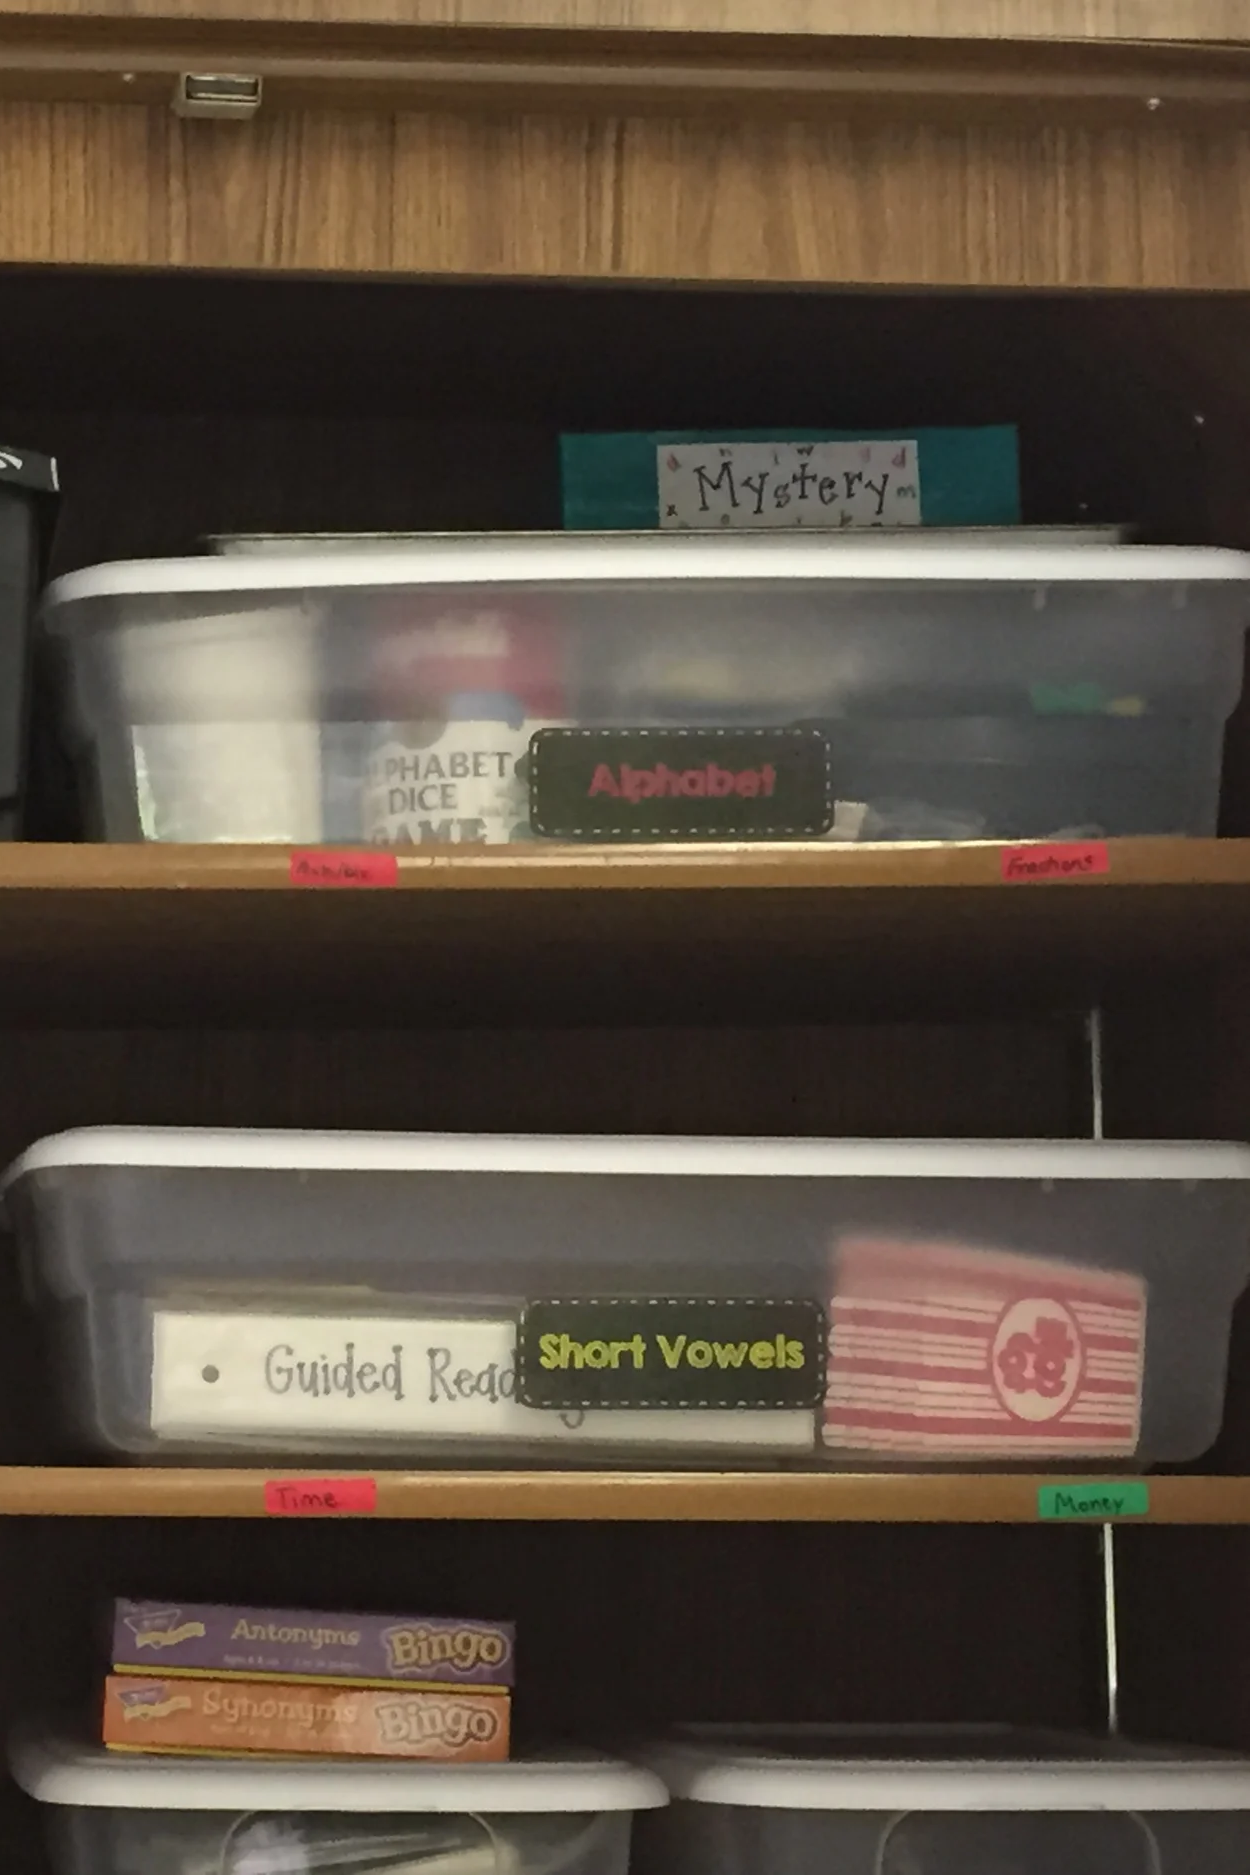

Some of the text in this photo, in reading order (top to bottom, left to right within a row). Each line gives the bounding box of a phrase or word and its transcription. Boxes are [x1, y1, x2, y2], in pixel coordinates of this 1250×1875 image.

[693, 460, 889, 516] Mystery
[364, 751, 513, 782] PHABET
[588, 761, 776, 804] Alphabet
[388, 783, 459, 815] DICE
[264, 1342, 405, 1401] Guided
[538, 1333, 805, 1370] Short Vowels
[274, 1486, 338, 1510] Time
[1054, 1491, 1125, 1515] Money
[230, 1618, 362, 1650] Antonyms
[386, 1625, 509, 1672] Bingo
[202, 1686, 500, 1748] Synonyms Bingo
